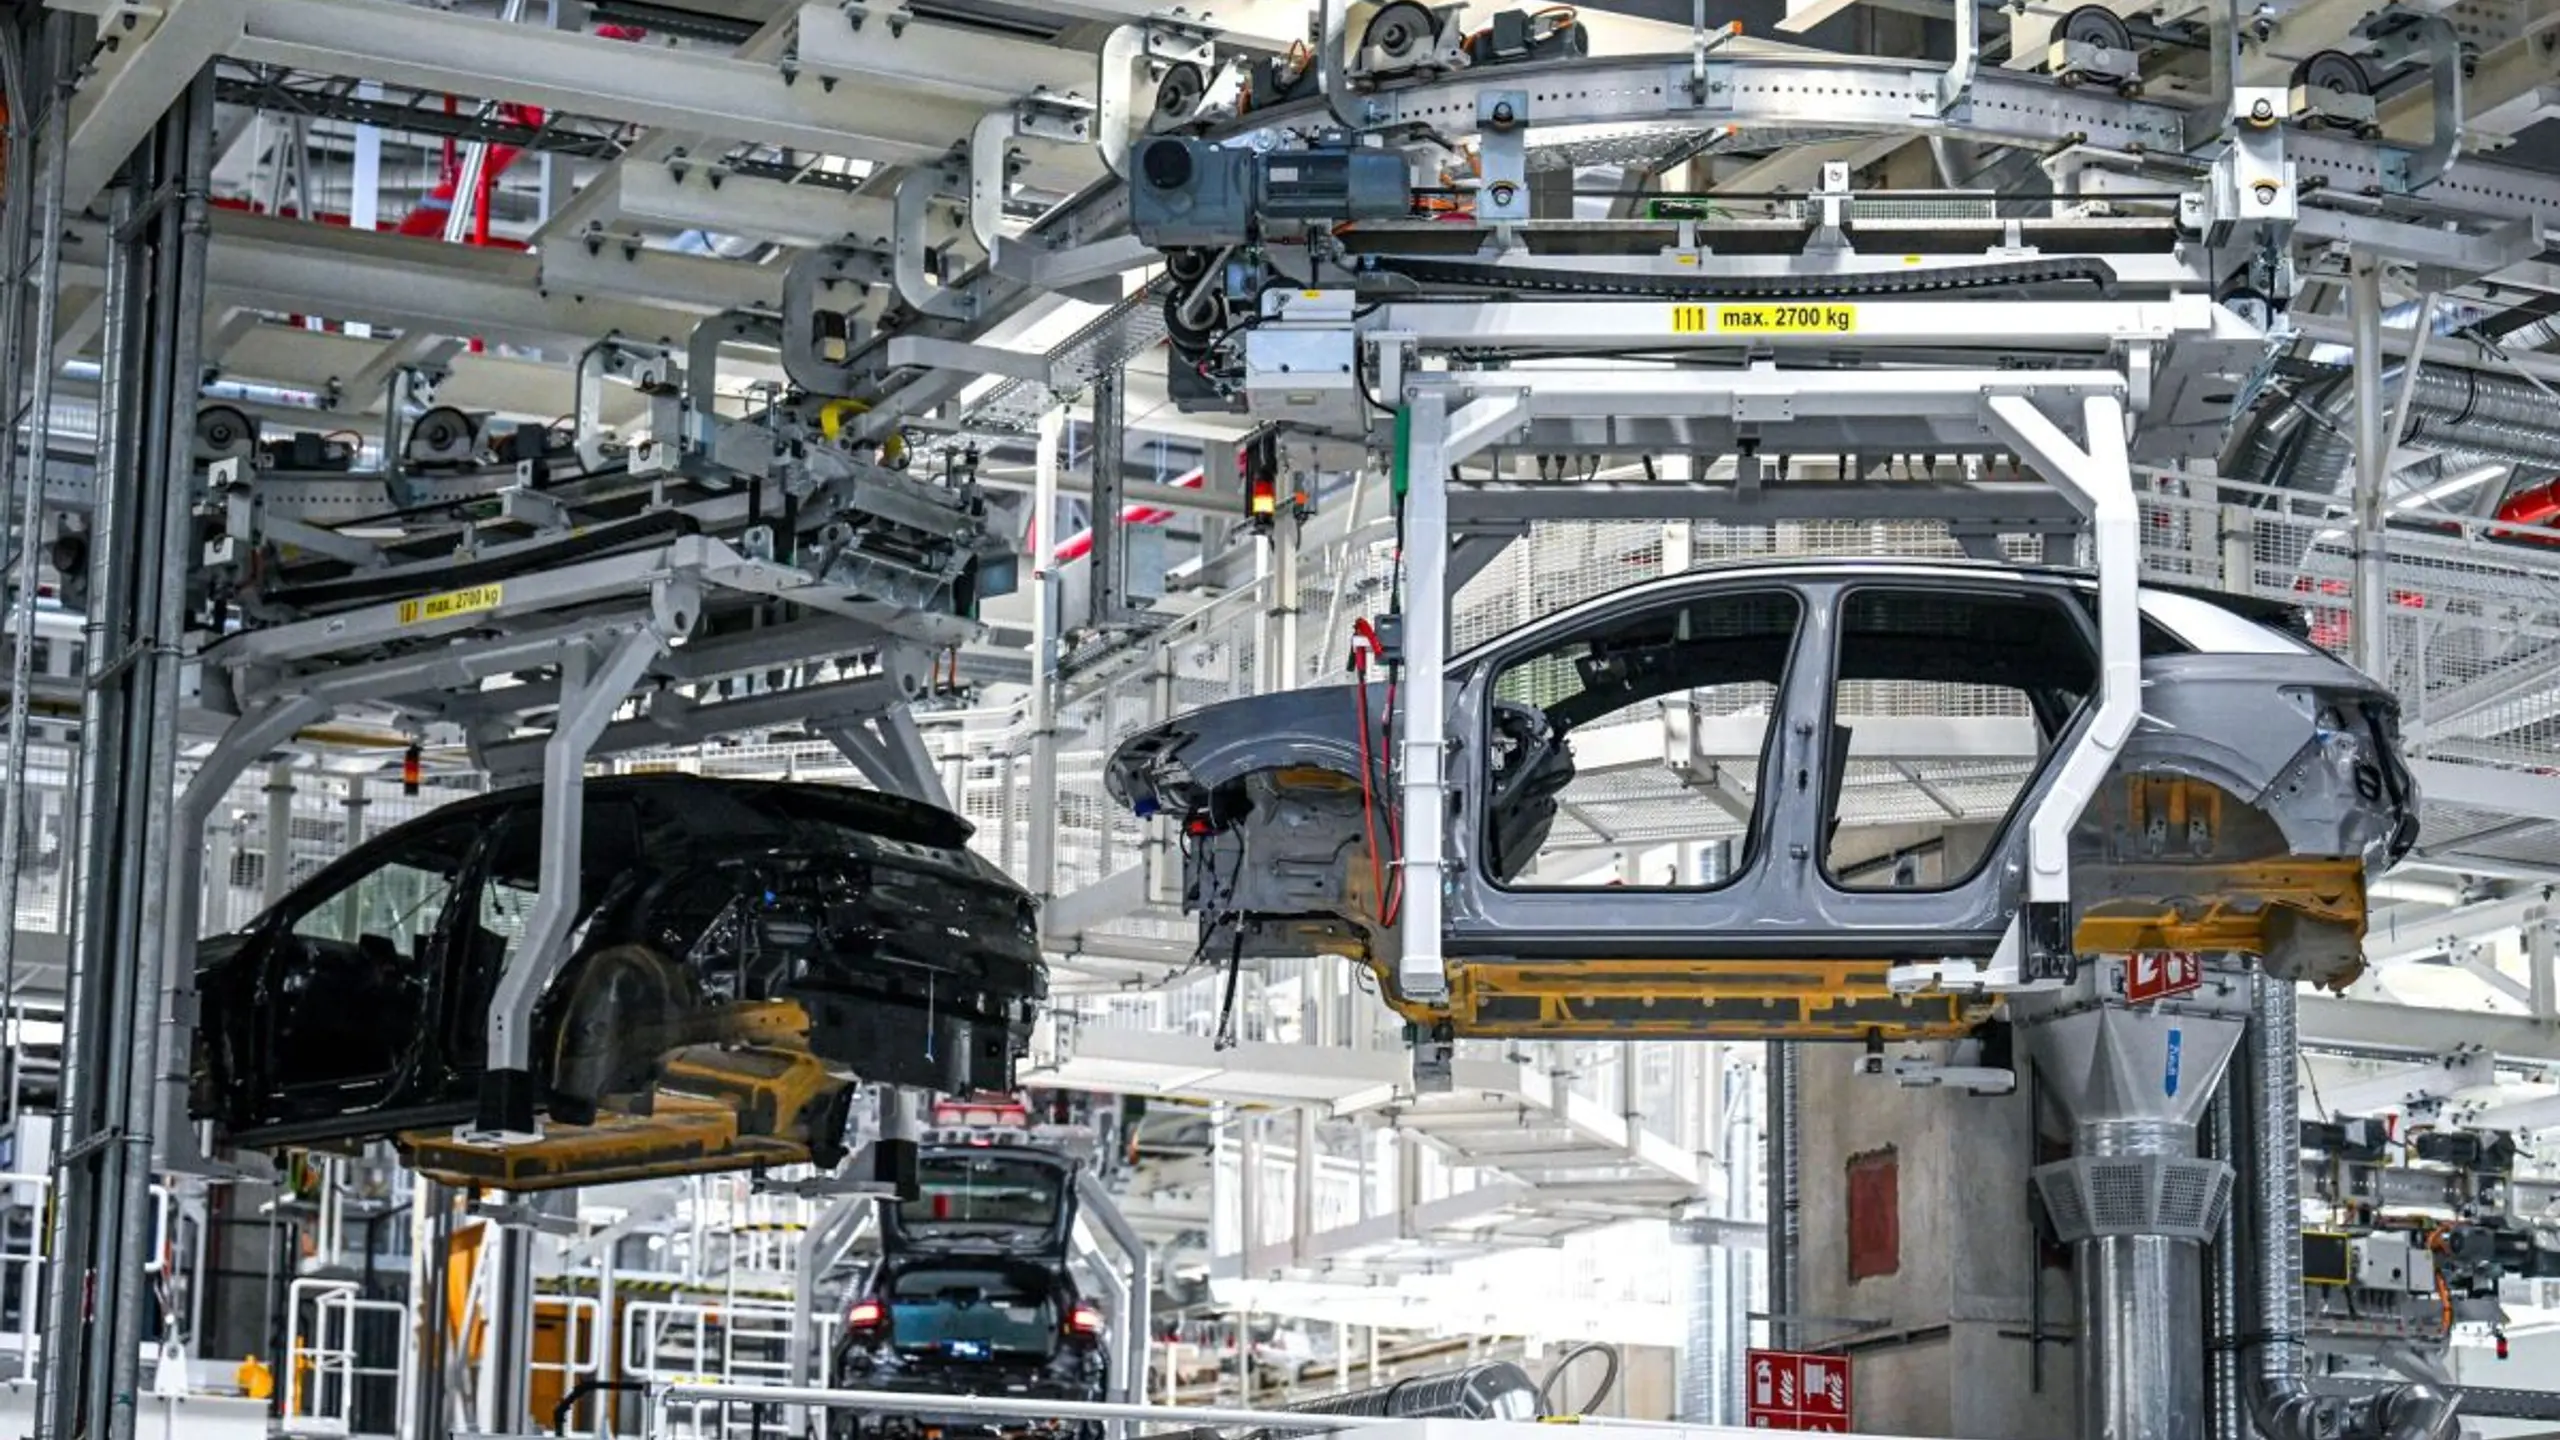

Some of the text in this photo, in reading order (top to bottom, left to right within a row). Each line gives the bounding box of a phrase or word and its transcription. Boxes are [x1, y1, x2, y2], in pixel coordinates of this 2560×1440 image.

[1723, 307, 1849, 331] max. 2700 kg
[484, 587, 499, 606] kg
